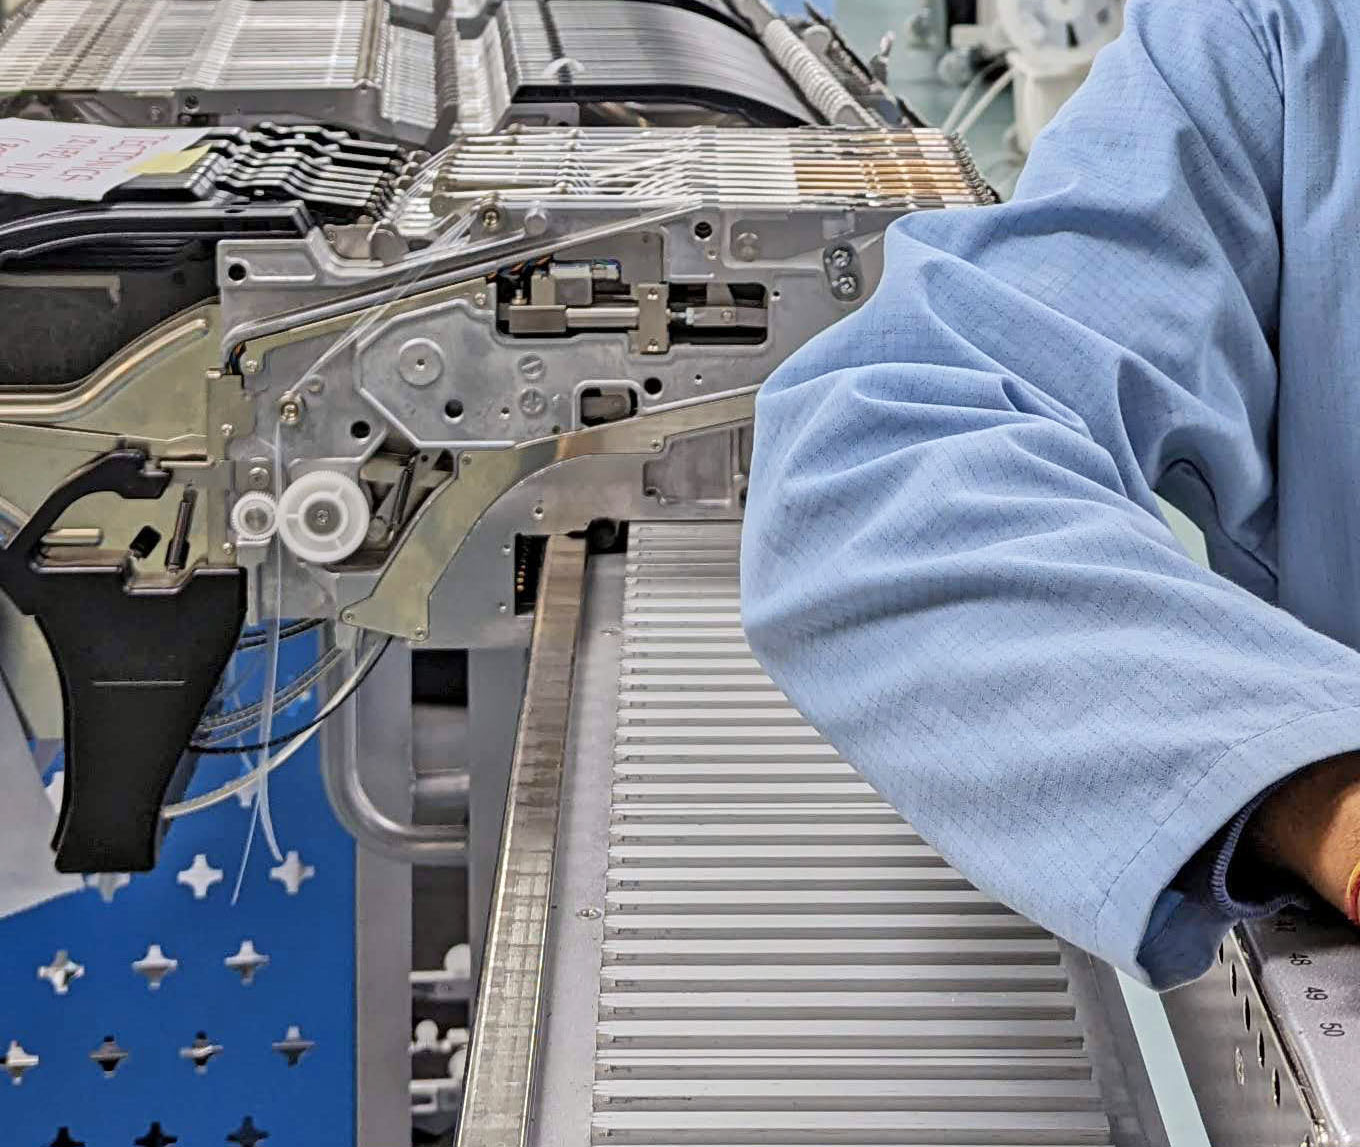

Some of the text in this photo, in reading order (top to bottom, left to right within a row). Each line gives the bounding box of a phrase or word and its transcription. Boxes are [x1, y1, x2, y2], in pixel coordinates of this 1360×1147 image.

[1288, 952, 1313, 966] 48
[1303, 986, 1329, 1001] 49
[1320, 1022, 1346, 1037] 50
